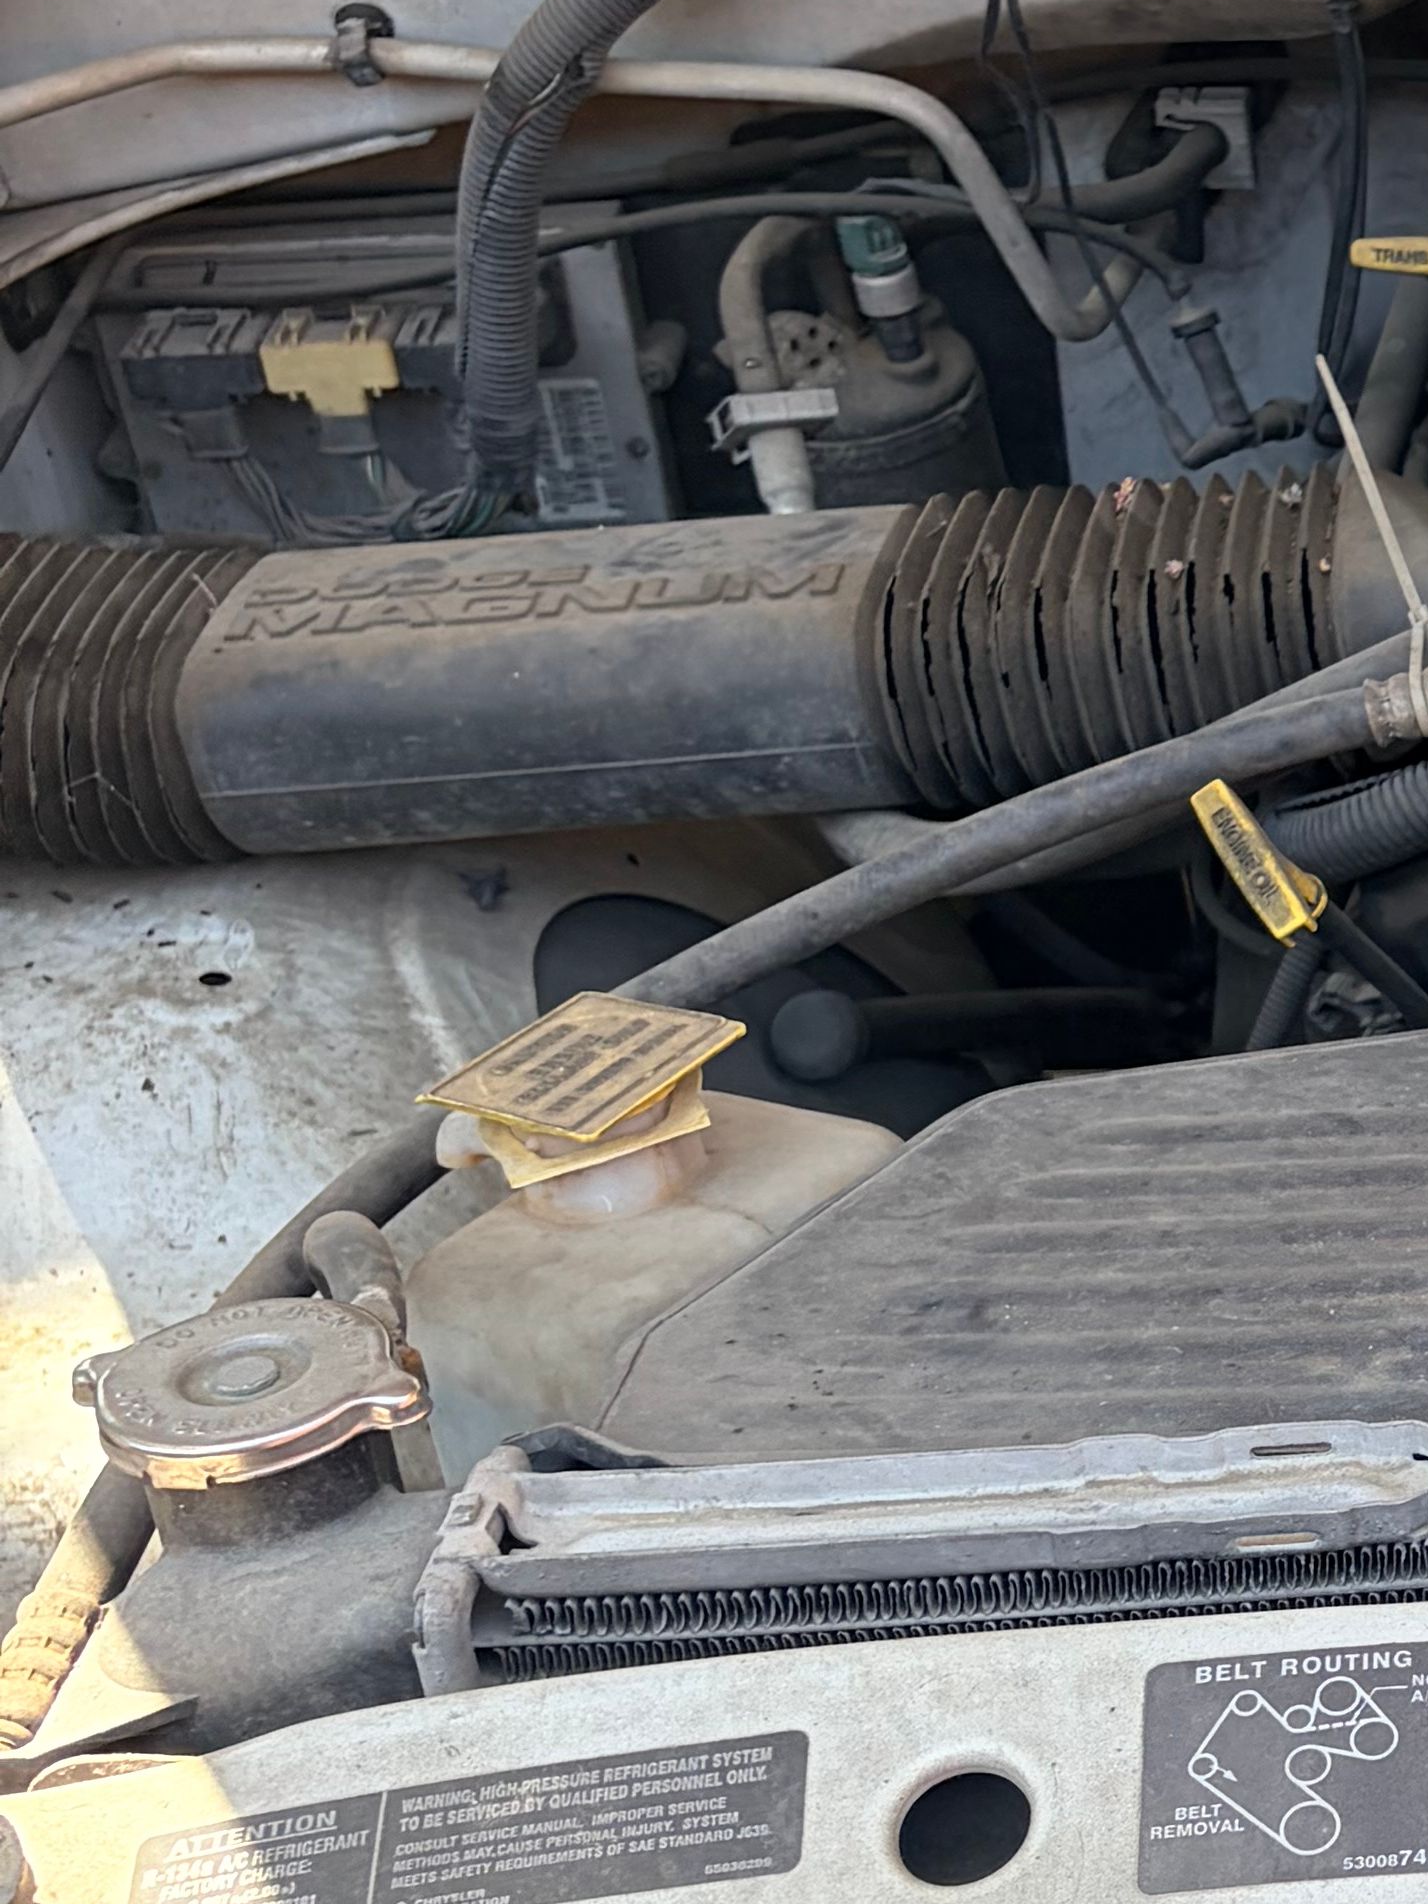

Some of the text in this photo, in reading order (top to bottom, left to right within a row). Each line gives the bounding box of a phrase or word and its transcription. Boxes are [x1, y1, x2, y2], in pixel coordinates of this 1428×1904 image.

[223, 562, 847, 643] MAGNUM
[1195, 1649, 1413, 1683] BELT ROUTING
[478, 1771, 600, 1802] HIGH-PRESSURE
[602, 1755, 708, 1783] REFRIGERANT
[711, 1746, 773, 1767] SYSTEM
[394, 1796, 727, 1856] CONSULT SERVICE IMPROPER SERVICE
[397, 1816, 420, 1833] TO
[421, 1812, 444, 1830] BE
[445, 1802, 520, 1825] SERVICED
[523, 1797, 546, 1815] BY
[547, 1786, 628, 1810] QUALIFIED
[630, 1771, 723, 1798] PERSONNEL
[1174, 1803, 1221, 1822] BELT
[167, 1809, 337, 1858] ATTENTION
[216, 1829, 370, 1873] A/C REFRIGERANT
[496, 1839, 545, 1857] CAUSE
[545, 1829, 617, 1849] PERSONAL
[681, 1810, 740, 1830] SYSTEM
[1150, 1817, 1246, 1840] REMOVAL
[239, 1859, 313, 1886] CHARGE:
[390, 1828, 734, 1889] MEETS SAFETY REQUIREMENTS OF SAE STANDARD
